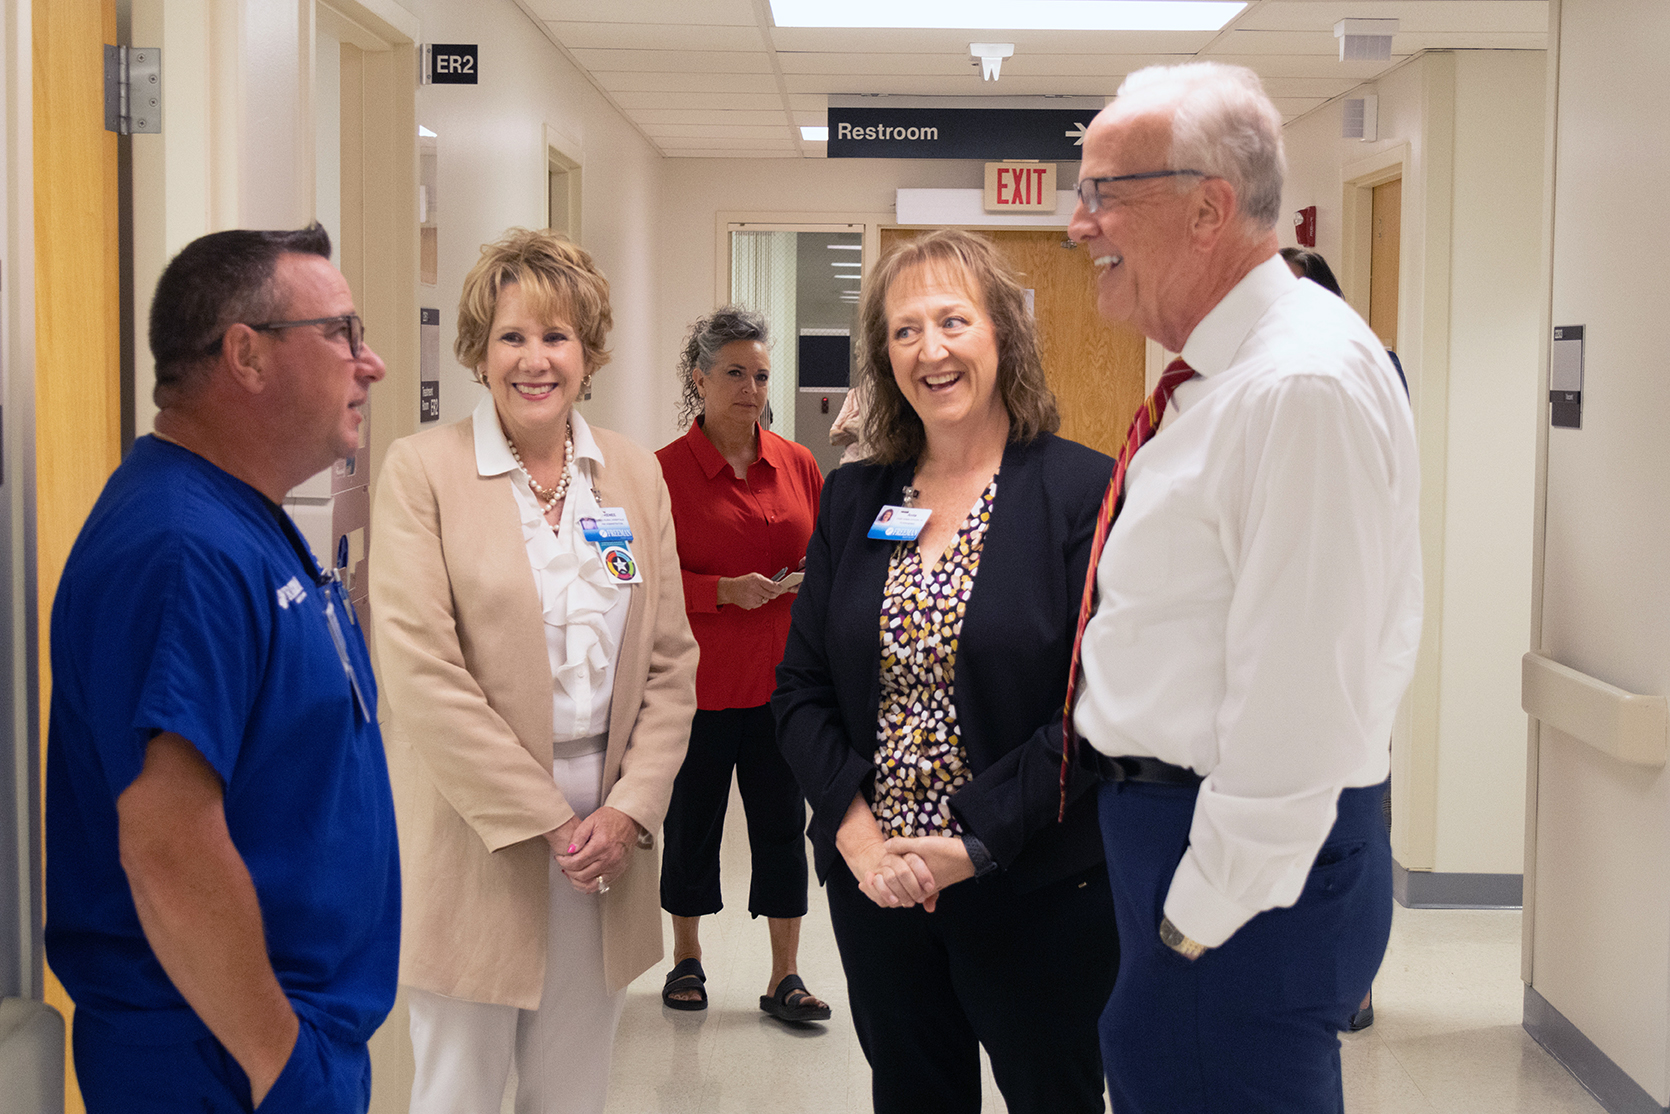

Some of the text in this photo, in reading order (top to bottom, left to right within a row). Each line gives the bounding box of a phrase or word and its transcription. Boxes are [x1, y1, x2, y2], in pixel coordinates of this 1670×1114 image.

[437, 55, 474, 73] ER2
[837, 122, 939, 141] Restroom
[997, 168, 1047, 205] EXIT
